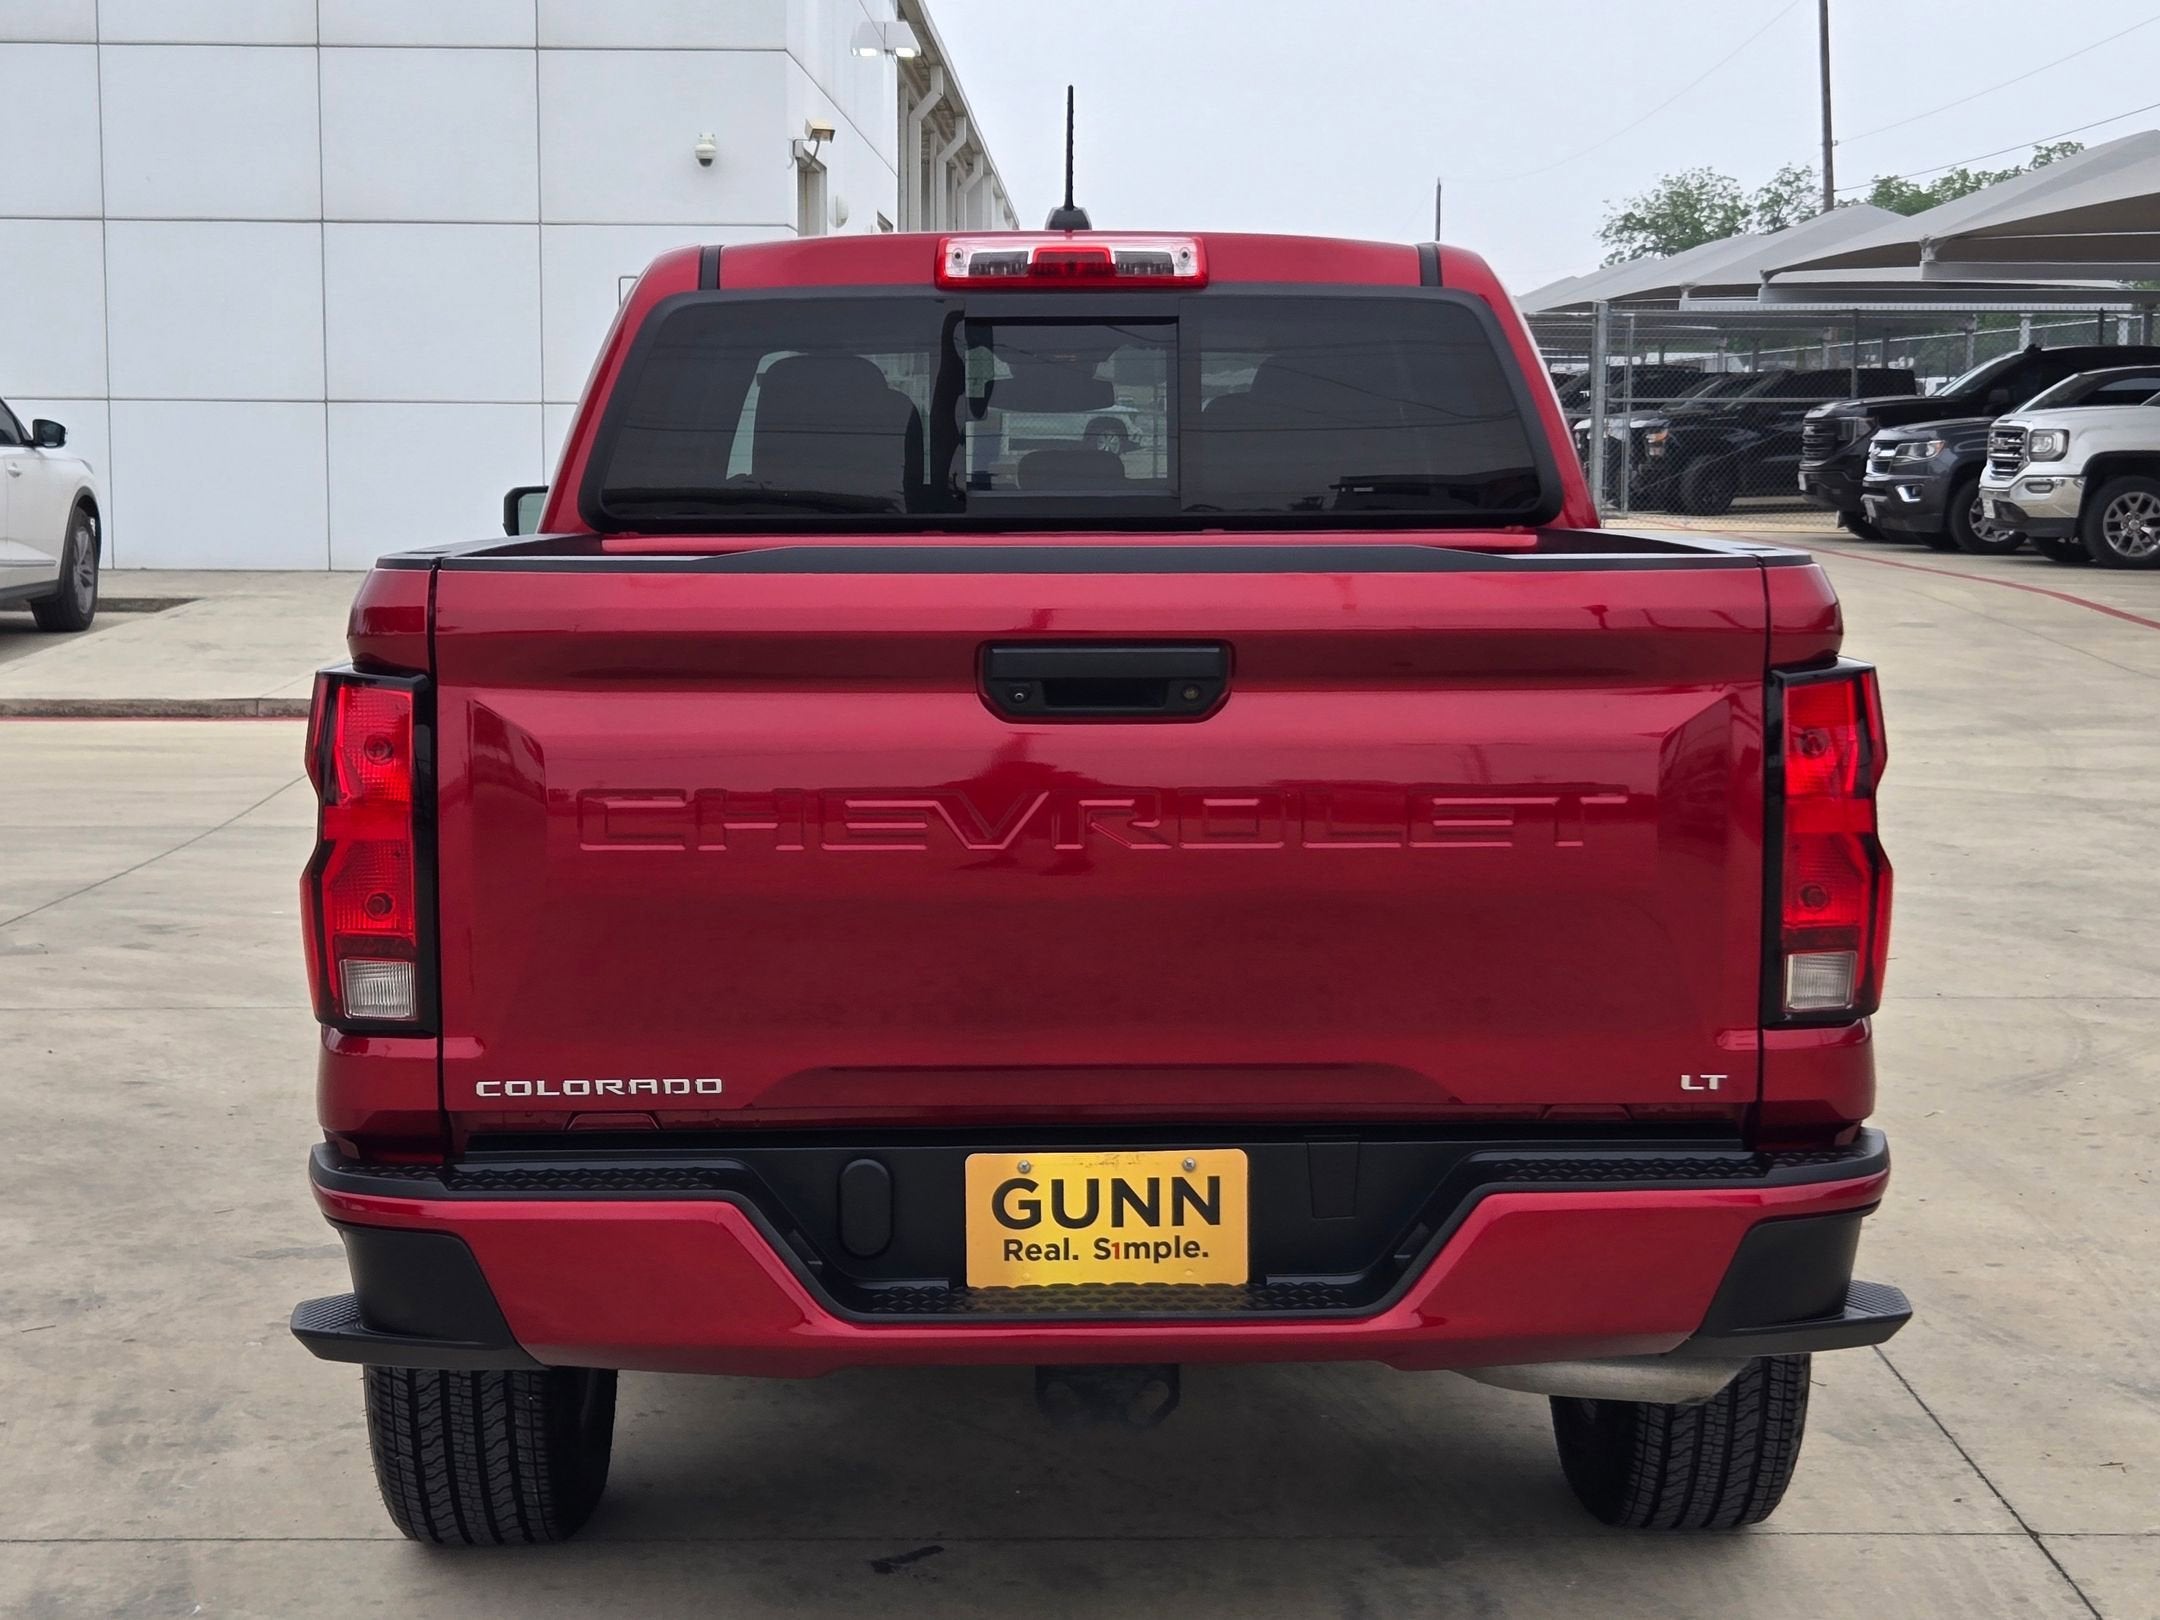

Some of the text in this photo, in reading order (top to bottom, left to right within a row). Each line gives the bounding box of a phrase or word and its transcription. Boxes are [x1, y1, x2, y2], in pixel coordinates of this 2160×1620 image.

[577, 784, 1629, 852] CHEVROLET
[475, 1078, 723, 1097] COLORADO
[1680, 1074, 1728, 1090] LT
[991, 1175, 1221, 1230] GUNN
[1003, 1237, 1079, 1262] Real.
